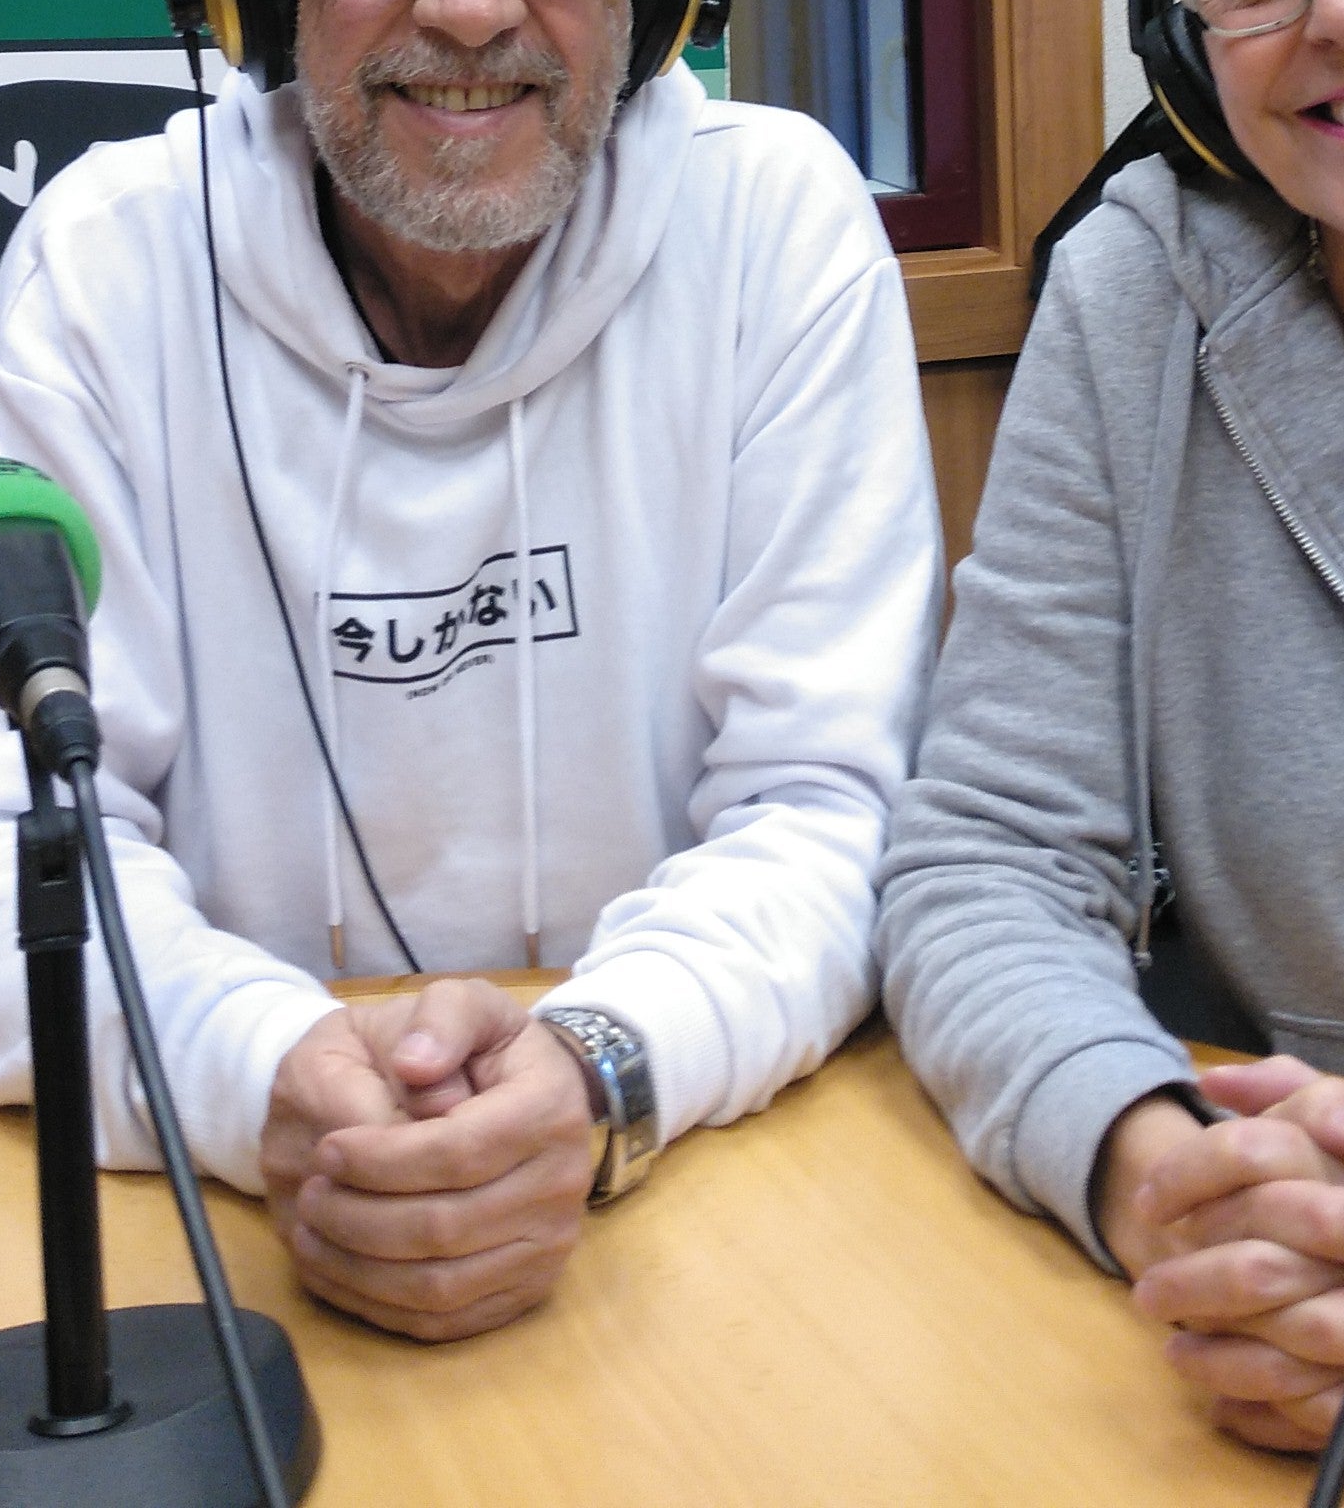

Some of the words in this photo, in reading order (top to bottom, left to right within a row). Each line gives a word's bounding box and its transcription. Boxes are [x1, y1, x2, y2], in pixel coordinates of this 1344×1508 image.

[332, 578, 558, 663] 今しかない
